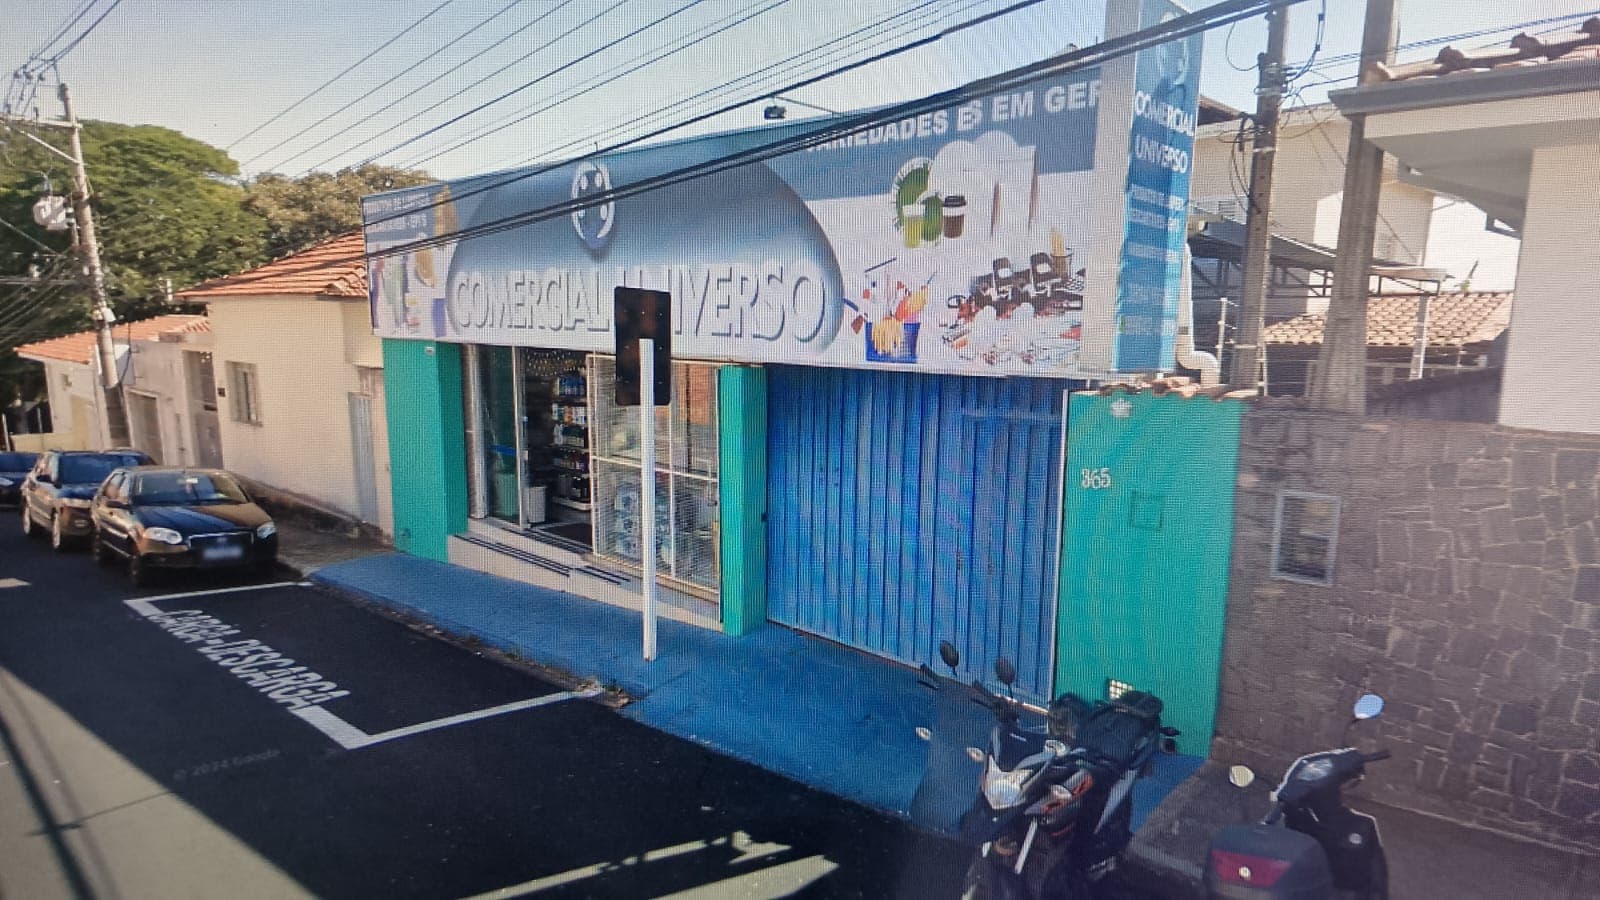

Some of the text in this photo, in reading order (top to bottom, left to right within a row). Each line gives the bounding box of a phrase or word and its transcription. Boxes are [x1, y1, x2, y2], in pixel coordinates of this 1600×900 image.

[992, 90, 1034, 122] EM
[1135, 90, 1194, 136] COMERCIAL
[1135, 134, 1188, 174] UNIVERSO
[453, 259, 827, 342] COMERCIAL IVERSO
